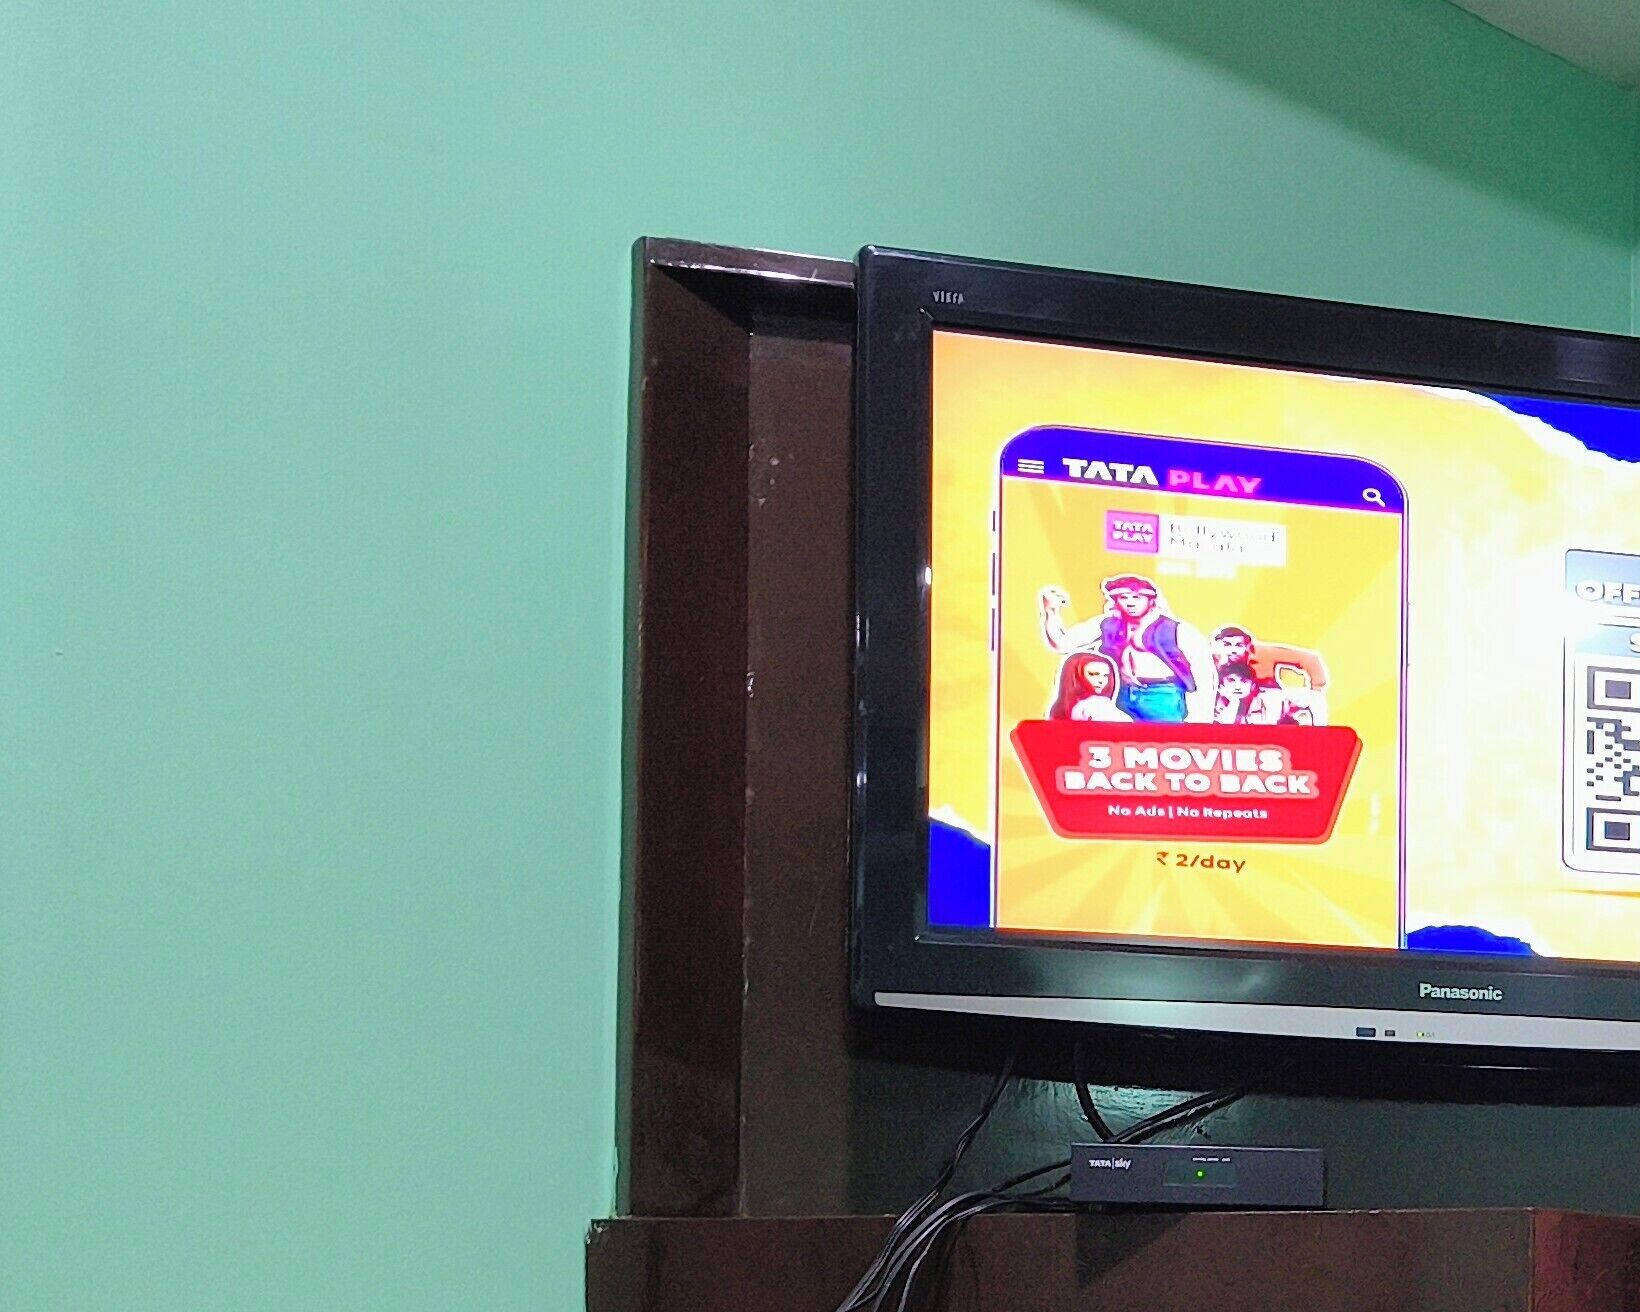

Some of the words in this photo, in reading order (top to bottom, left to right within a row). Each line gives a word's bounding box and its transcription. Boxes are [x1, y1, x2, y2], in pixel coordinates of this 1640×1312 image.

[1062, 457, 1160, 487] TATA
[1169, 469, 1262, 494] PLAY
[1112, 520, 1154, 534] TATA
[1111, 532, 1154, 544] PLAY
[1088, 746, 1112, 769] 3
[1123, 746, 1284, 772] MOVIES
[1064, 771, 1157, 791] BACK
[1165, 773, 1211, 792] TO
[1219, 774, 1311, 794] BACK
[1108, 805, 1130, 816] No
[1135, 805, 1165, 817] Ads
[1177, 806, 1199, 818] No
[1203, 807, 1268, 820] Repeats
[1176, 853, 1246, 873] 2/day
[1419, 982, 1503, 1001] Panasonic
